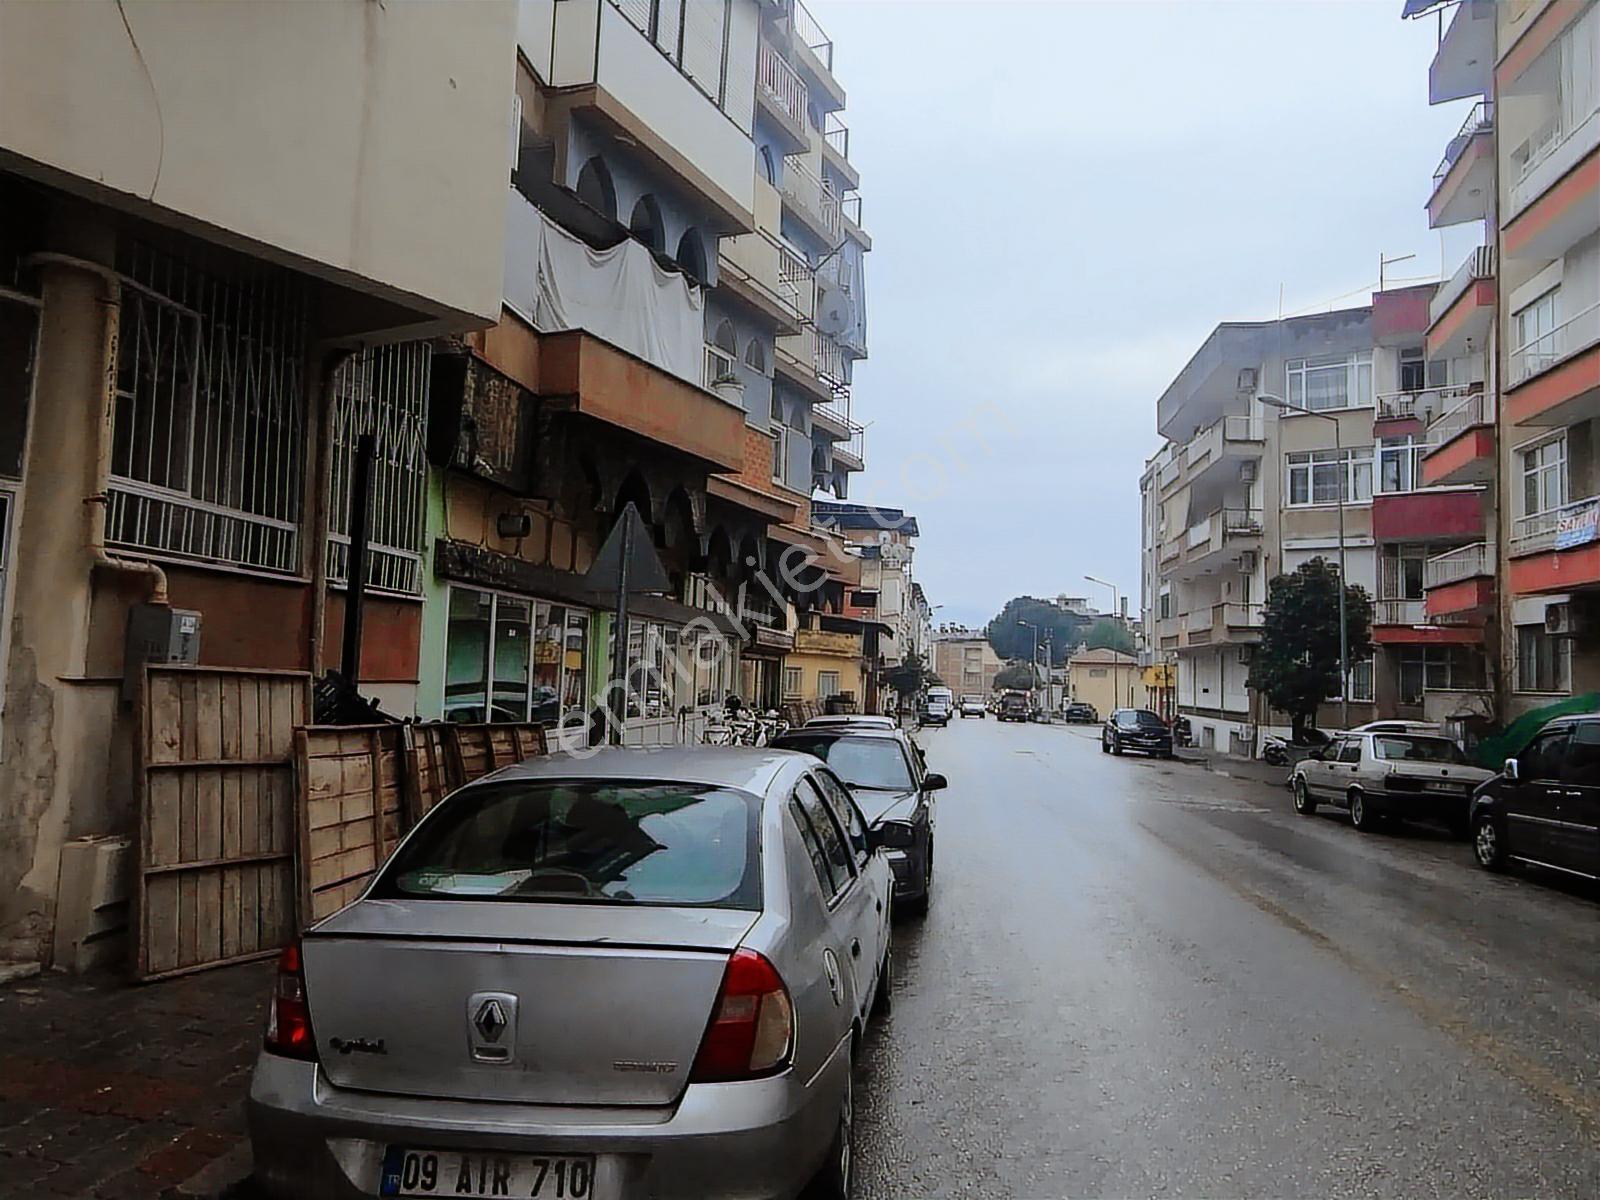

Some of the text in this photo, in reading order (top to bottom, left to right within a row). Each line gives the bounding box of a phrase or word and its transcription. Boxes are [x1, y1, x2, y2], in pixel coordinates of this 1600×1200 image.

[403, 1153, 438, 1191] 09
[455, 1156, 511, 1195] AIR
[530, 1158, 588, 1198] 710
